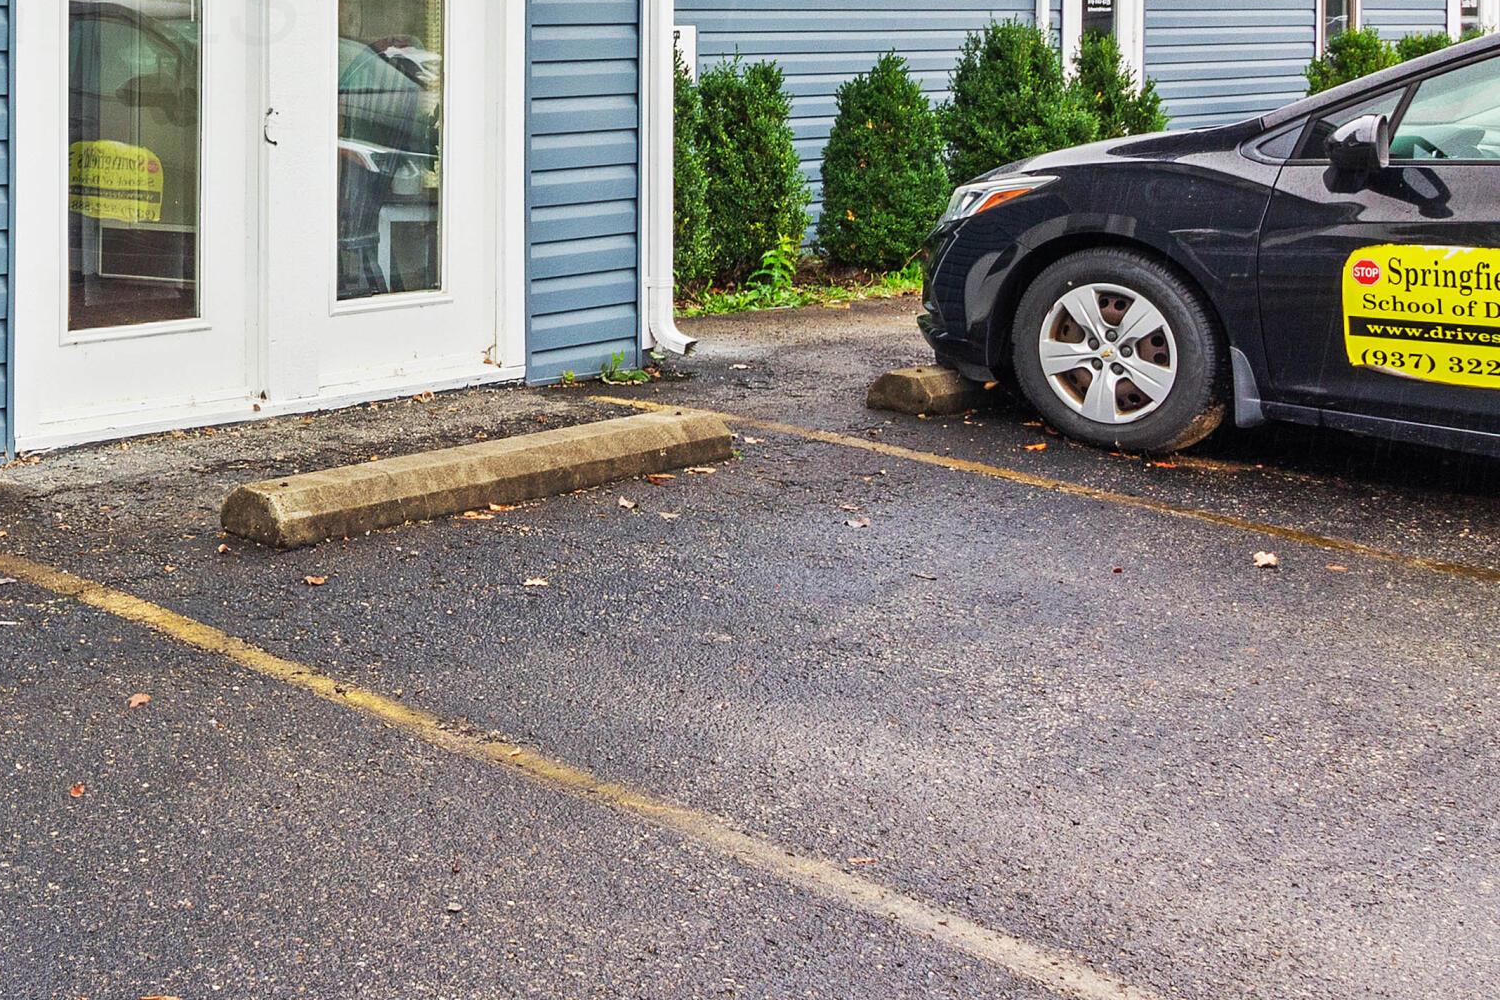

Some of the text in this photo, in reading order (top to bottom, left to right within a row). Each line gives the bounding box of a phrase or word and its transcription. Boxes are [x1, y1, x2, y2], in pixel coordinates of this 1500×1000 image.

[1353, 266, 1379, 278] STOP
[1362, 293, 1443, 315] School
[1452, 300, 1478, 317] of
[1361, 348, 1500, 376] (937) 322
